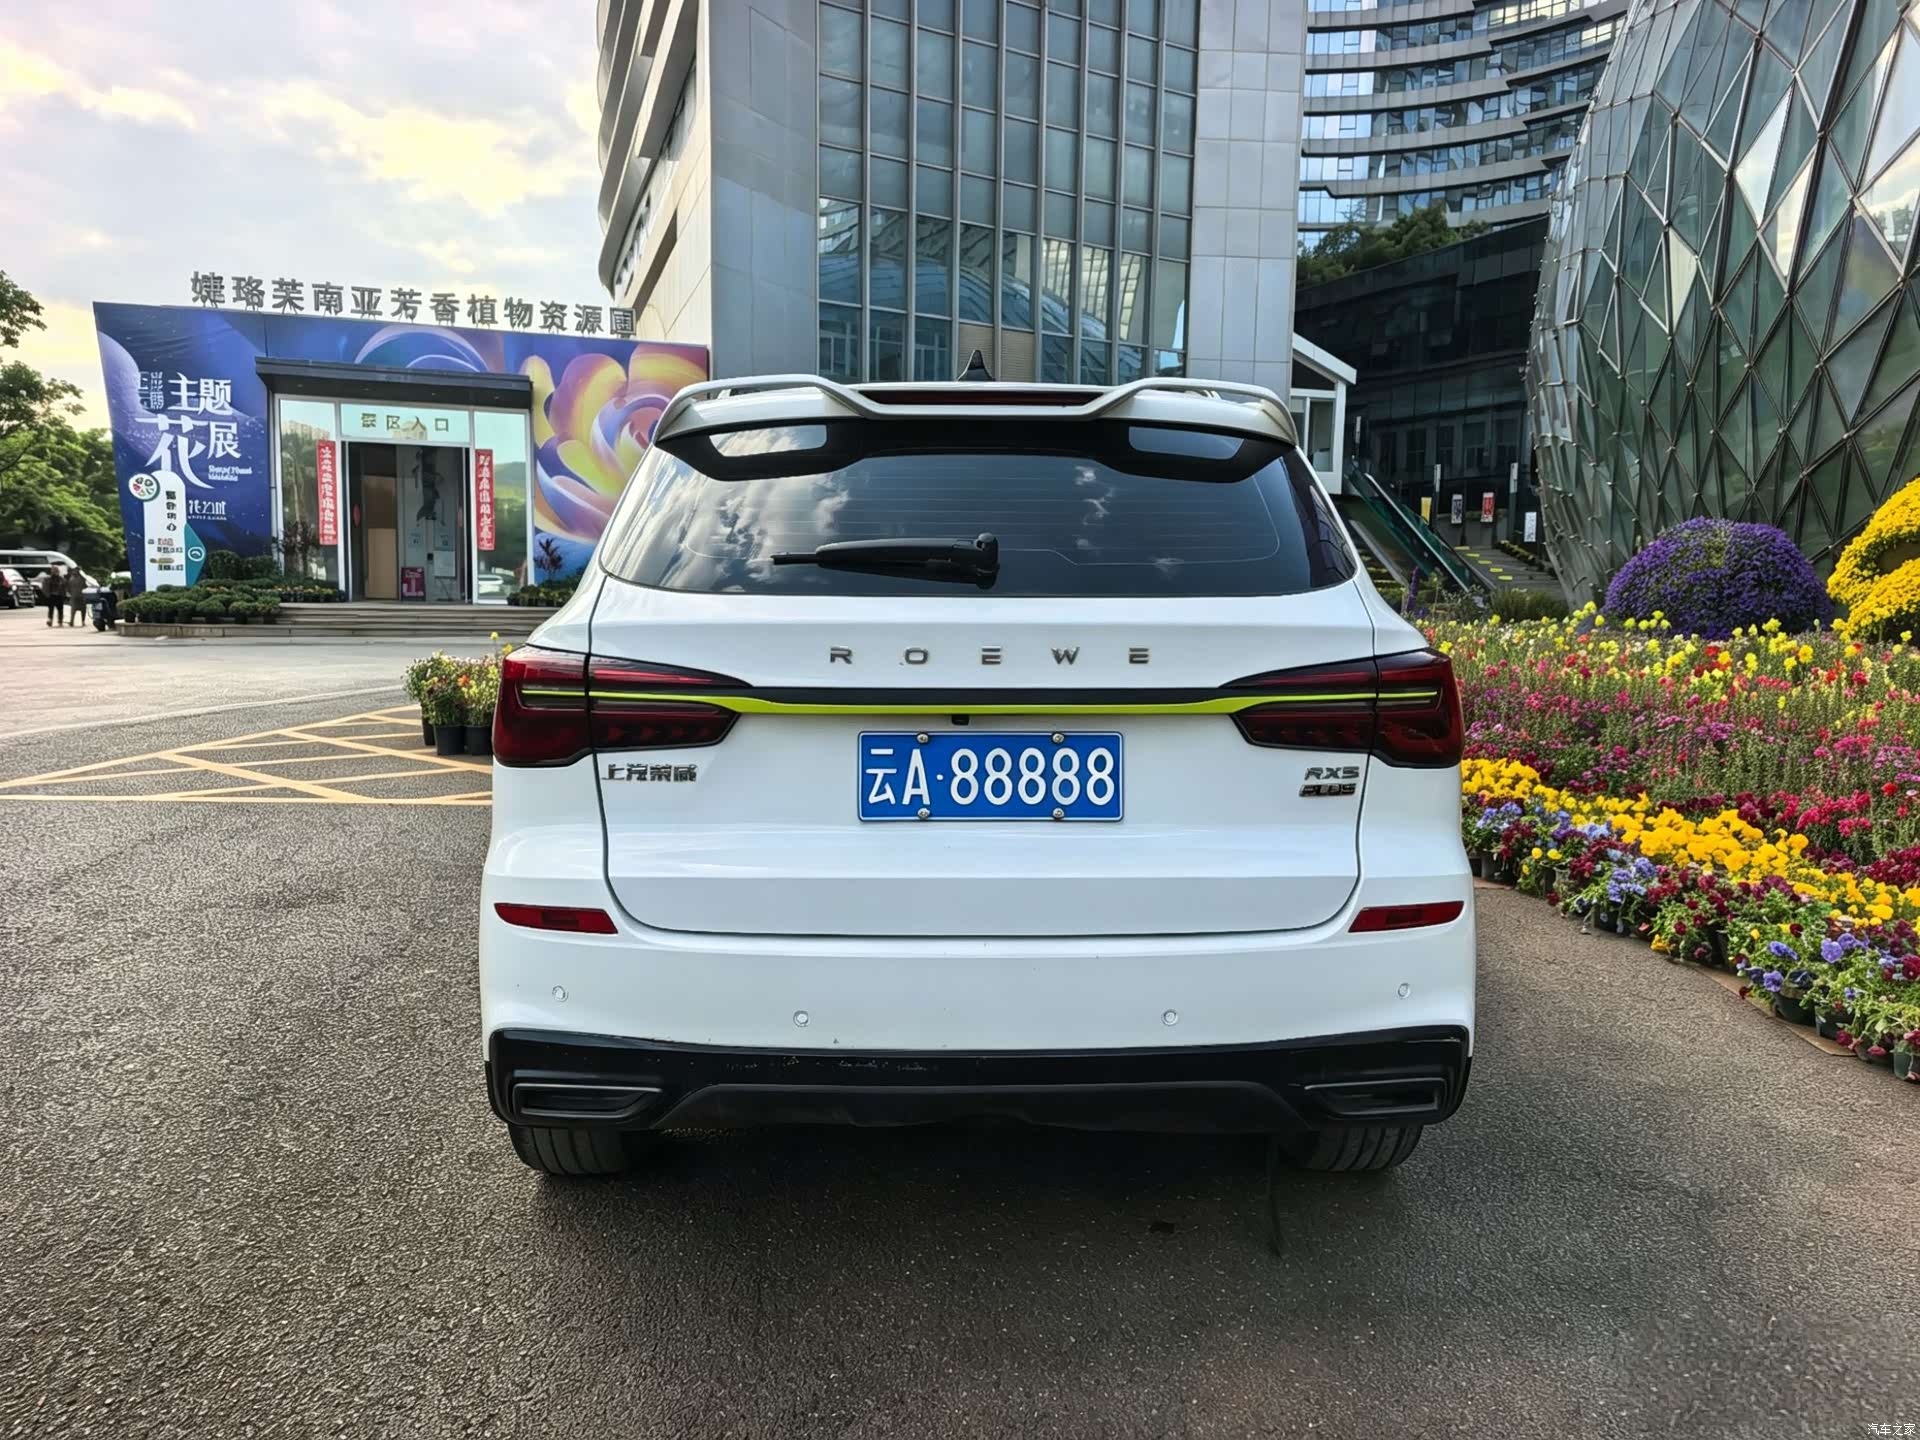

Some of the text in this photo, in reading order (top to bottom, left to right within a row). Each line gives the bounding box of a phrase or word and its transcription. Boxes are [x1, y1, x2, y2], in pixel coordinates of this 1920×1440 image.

[167, 372, 232, 415] 主题
[135, 414, 242, 489] 花展
[829, 646, 1150, 665] ROEWE
[602, 763, 698, 782] 上汽荣威
[1304, 766, 1360, 781] RX5
[1299, 783, 1357, 797] PLUS
